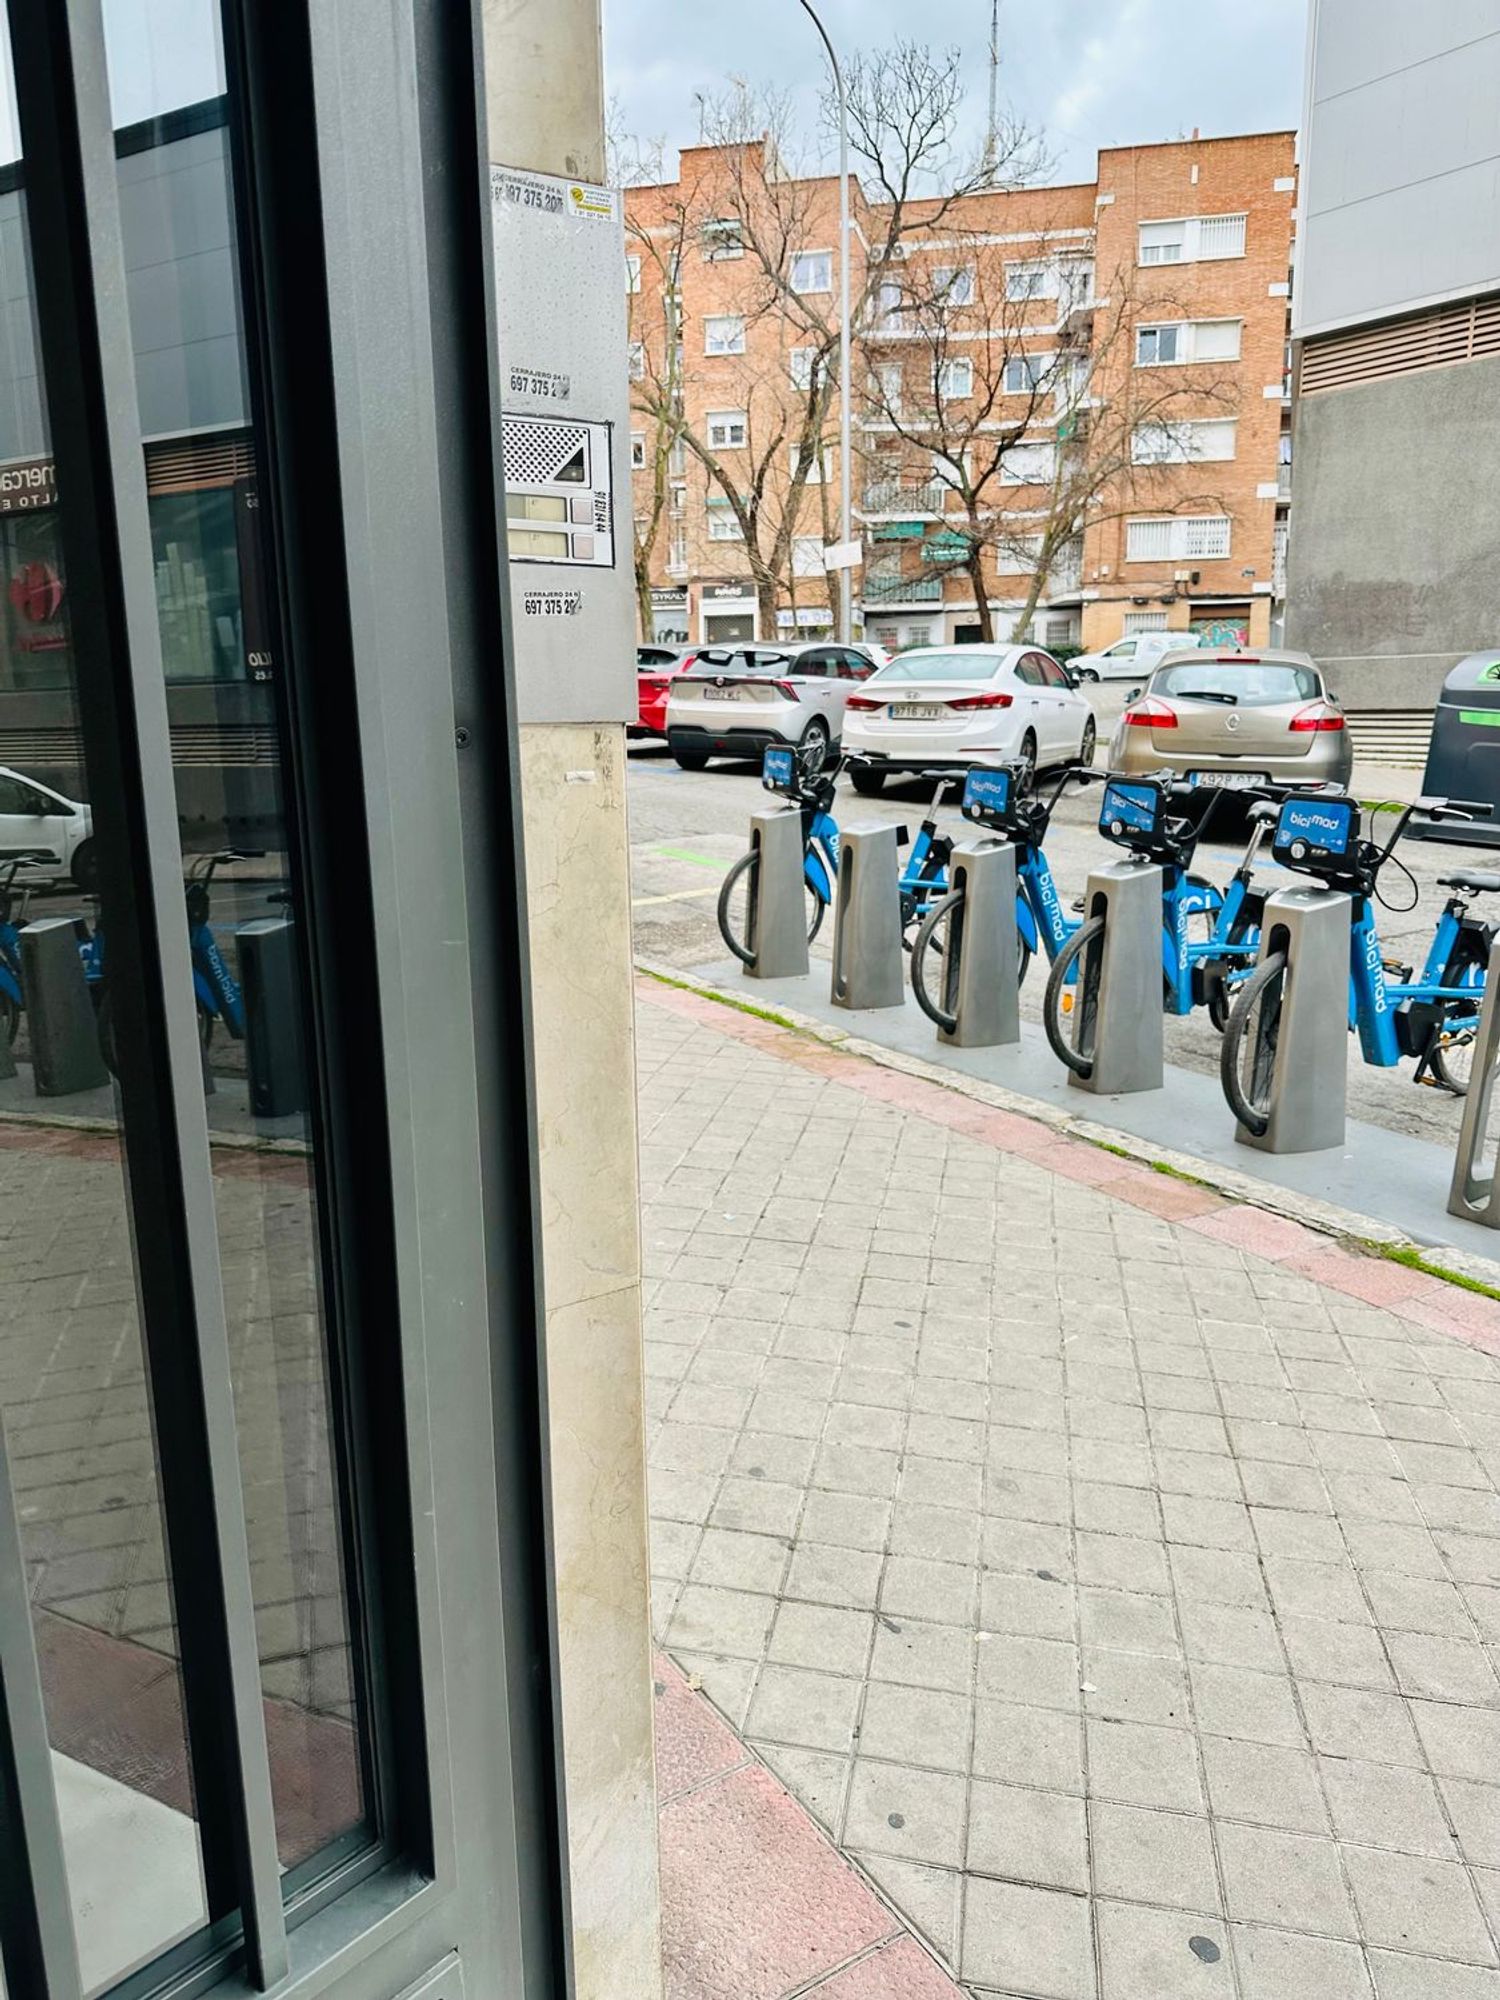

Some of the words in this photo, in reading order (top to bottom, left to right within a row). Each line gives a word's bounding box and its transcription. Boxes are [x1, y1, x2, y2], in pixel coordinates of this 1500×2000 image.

[524, 188, 542, 208] 375
[511, 375, 528, 393] 697
[531, 379, 549, 396] 375
[525, 599, 542, 615] 697
[545, 599, 562, 615] 375
